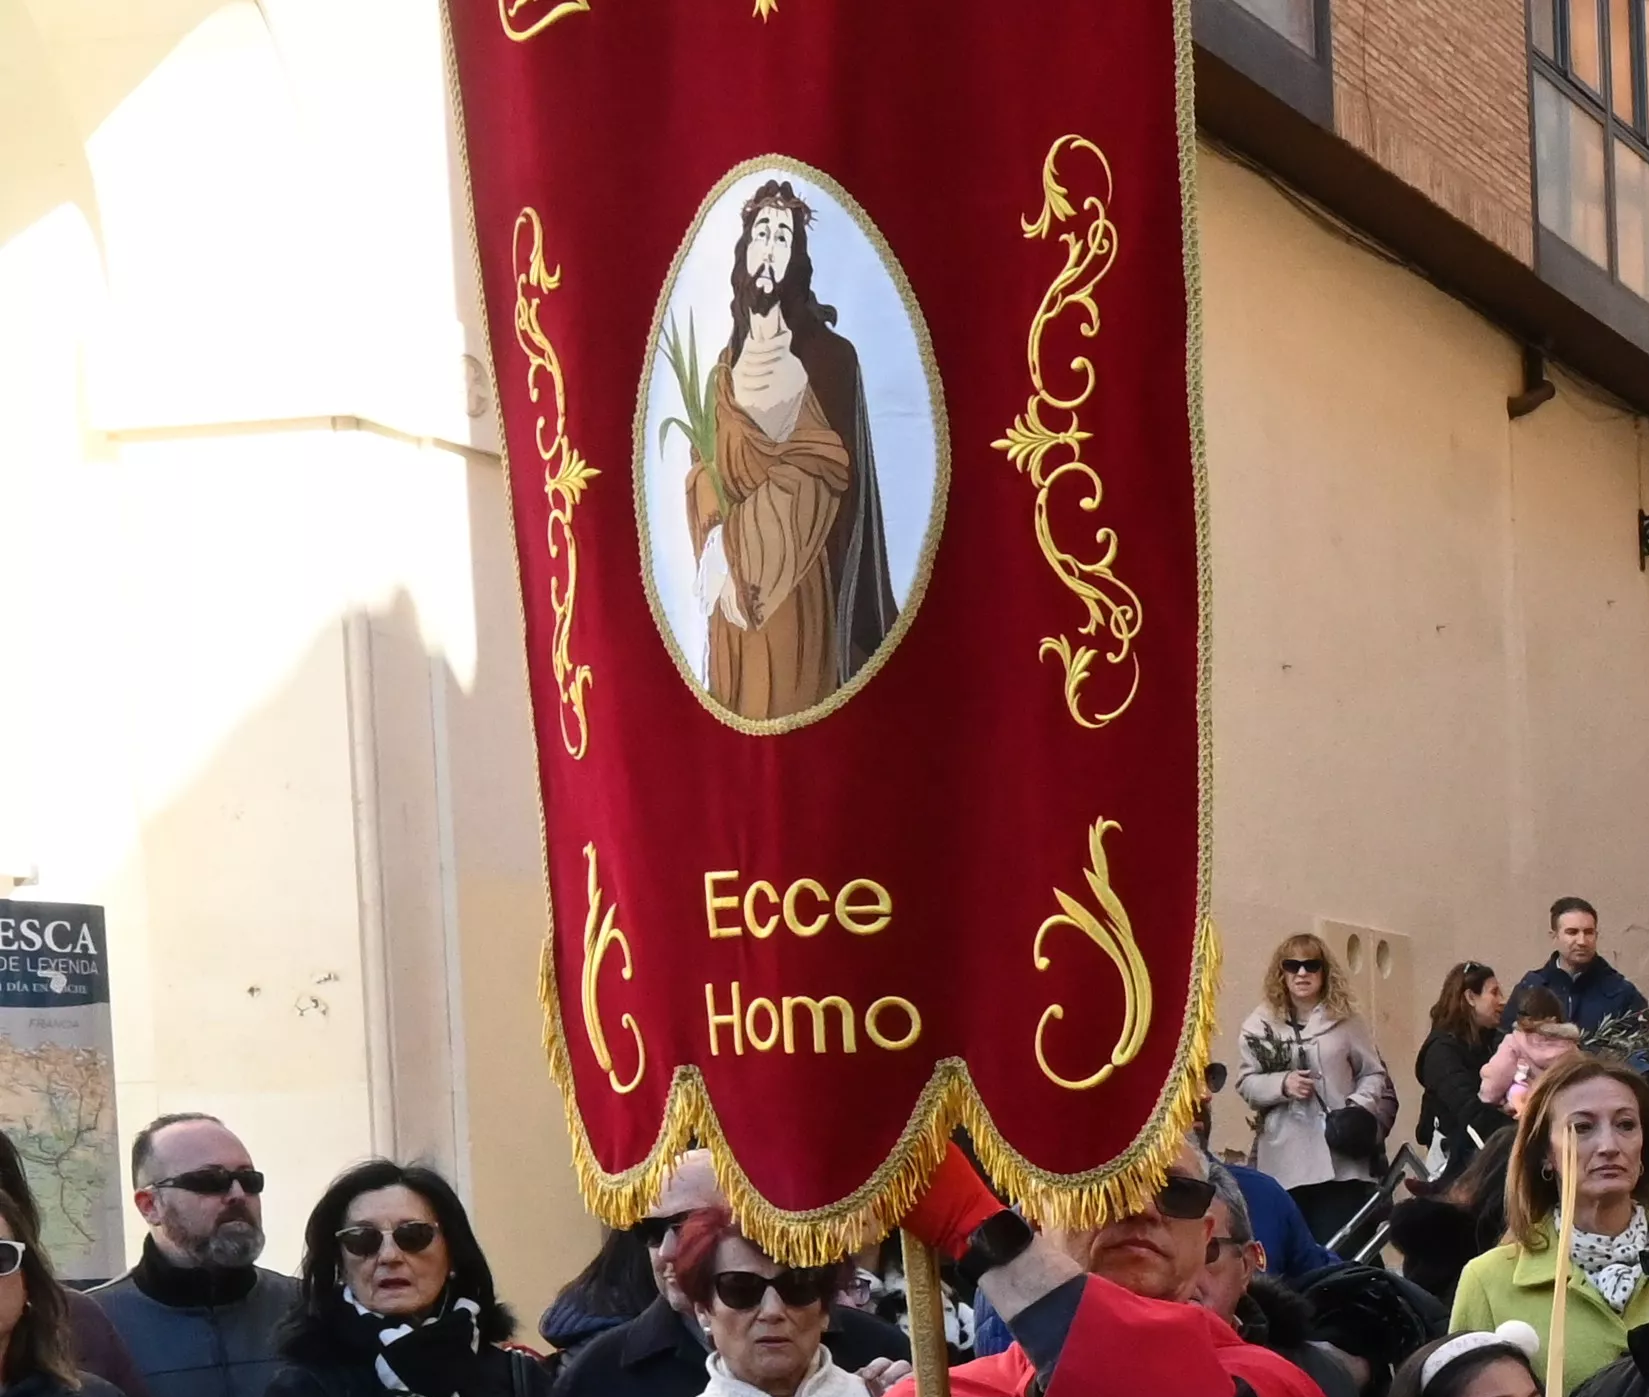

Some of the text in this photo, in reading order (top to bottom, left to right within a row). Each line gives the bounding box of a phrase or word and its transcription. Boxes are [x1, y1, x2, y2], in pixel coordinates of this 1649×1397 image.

[704, 870, 892, 938] Ecce
[0, 918, 98, 955] ESCA
[27, 957, 98, 974] LEYENDA
[704, 981, 921, 1056] Homo
